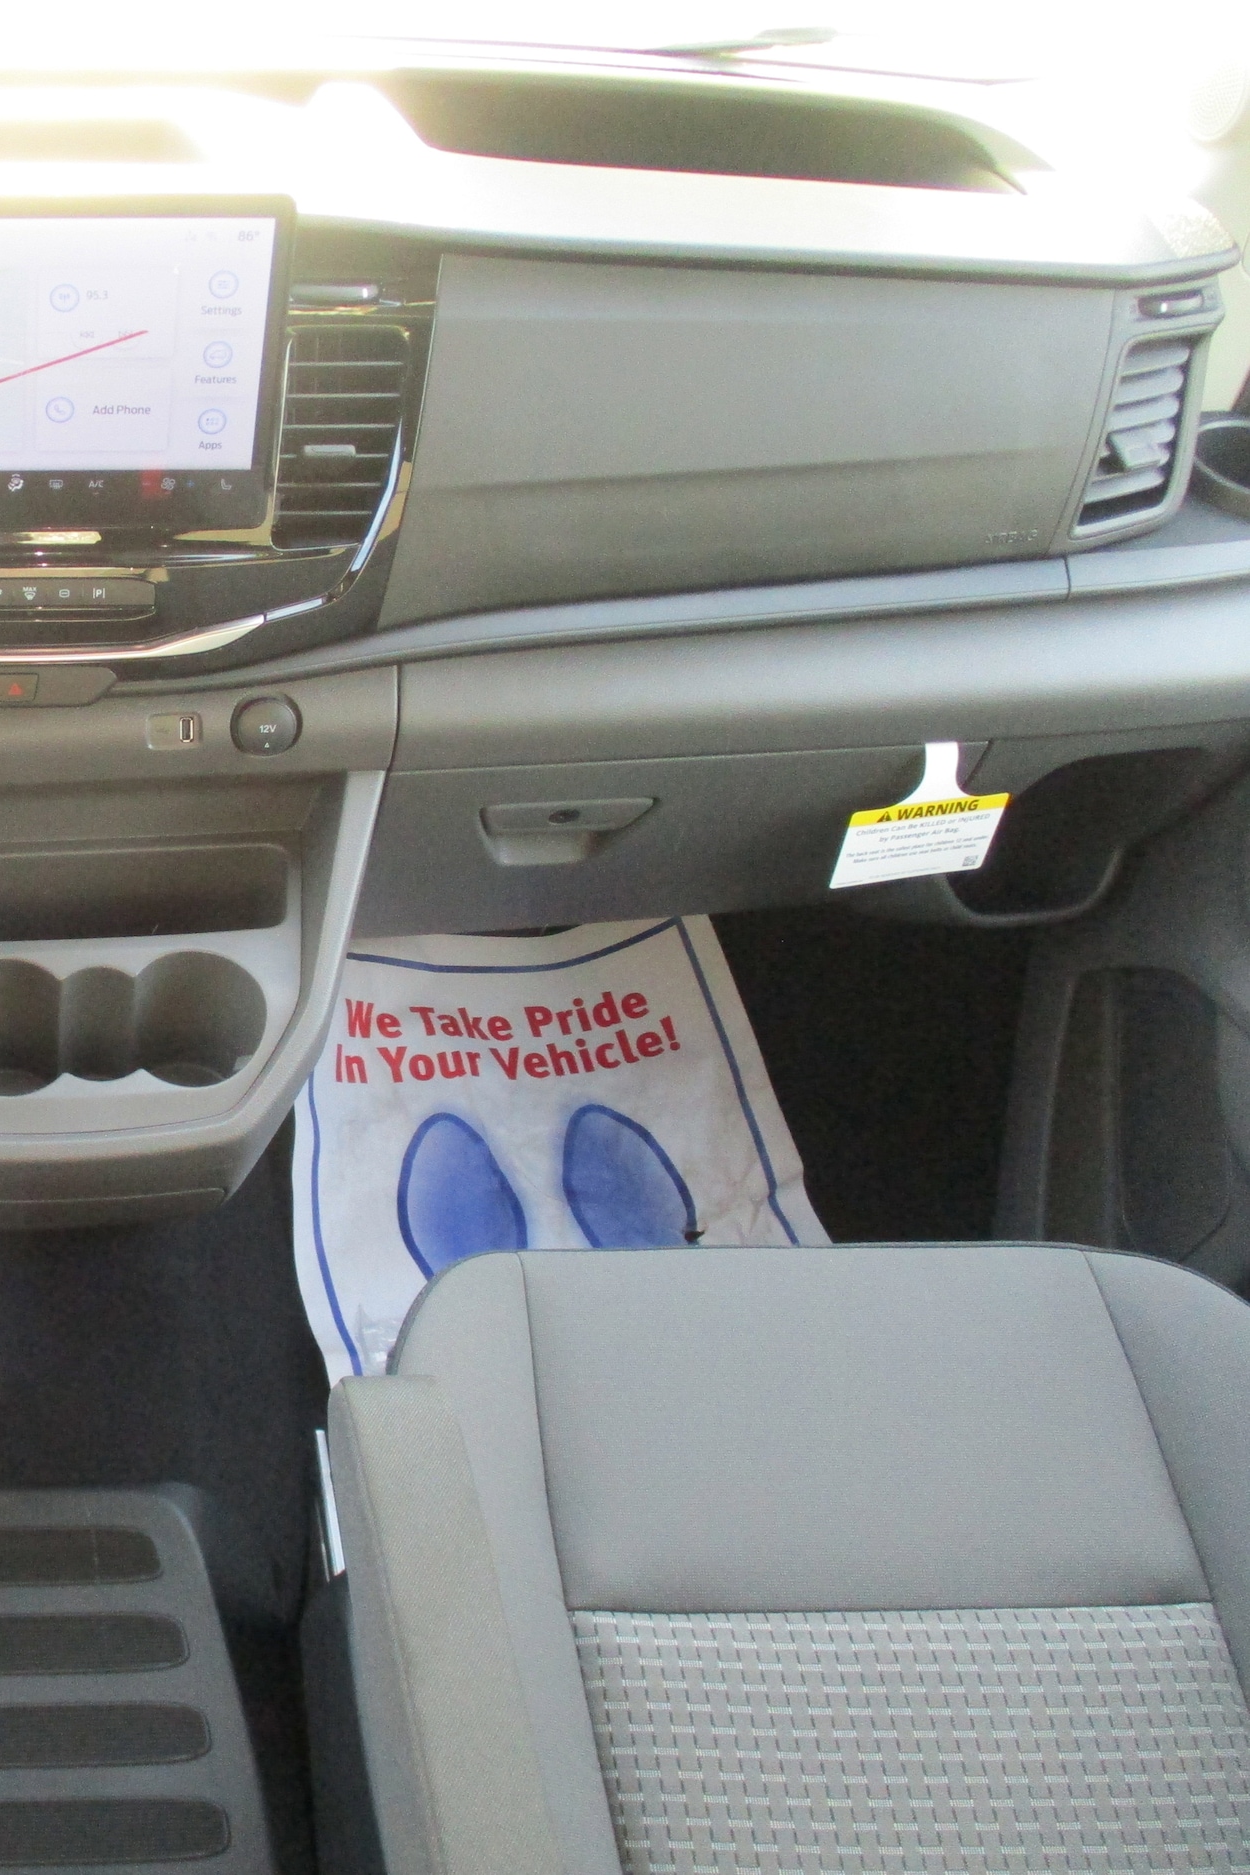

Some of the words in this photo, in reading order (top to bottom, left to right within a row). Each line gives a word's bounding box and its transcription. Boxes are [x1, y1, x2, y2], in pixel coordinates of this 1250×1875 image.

[201, 305, 242, 317] Settings
[194, 375, 238, 384] Features
[92, 405, 114, 415] Add
[116, 405, 151, 415] Phone
[198, 441, 222, 451] Apps
[258, 724, 278, 734] 12V
[898, 800, 980, 820] WARNING
[856, 826, 889, 836] Children
[919, 820, 945, 828] KILLED
[958, 814, 990, 823] INJURED
[890, 831, 928, 840] Passenger
[345, 998, 402, 1039] We
[409, 1006, 512, 1042] Take
[524, 991, 649, 1039] Pride
[335, 1044, 368, 1085] In
[376, 1046, 482, 1084] Your
[489, 1016, 682, 1080] Vehicle!
